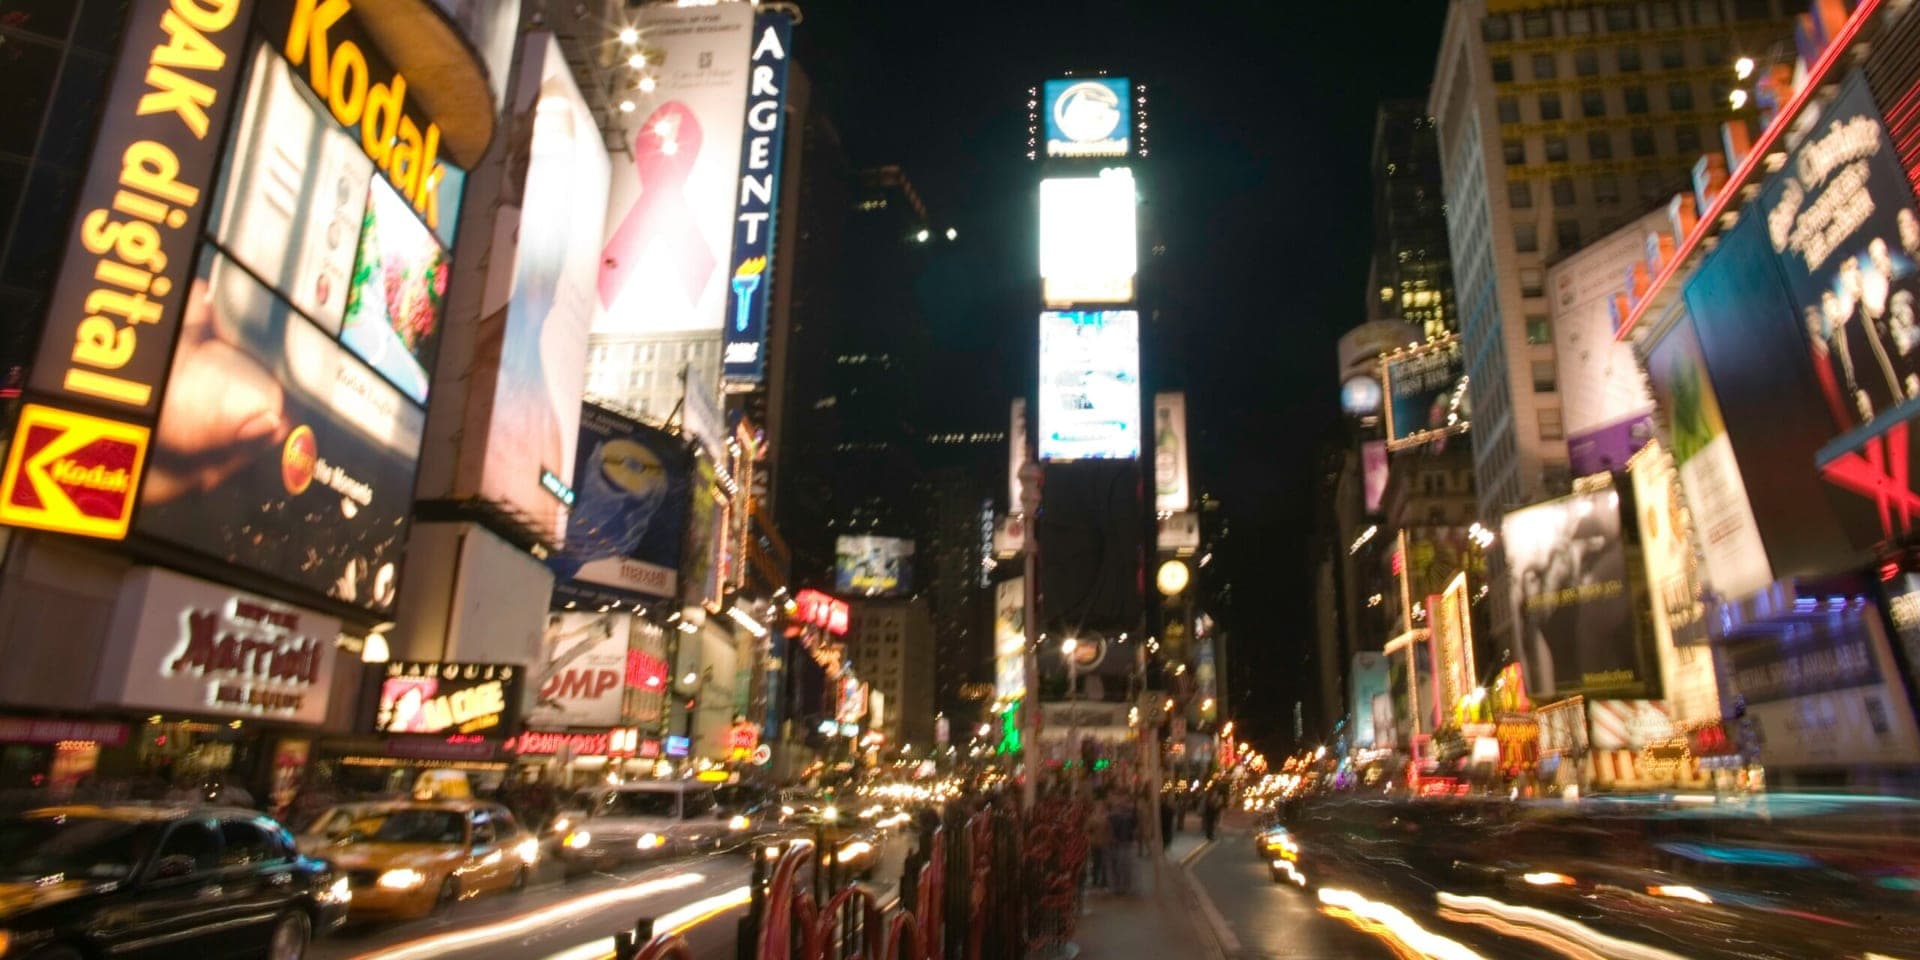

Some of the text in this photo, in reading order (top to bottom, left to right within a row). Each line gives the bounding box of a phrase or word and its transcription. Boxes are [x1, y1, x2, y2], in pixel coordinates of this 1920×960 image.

[286, 0, 446, 230] Kodak
[739, 26, 785, 244] ARGENT
[64, 141, 199, 406] digital
[52, 458, 130, 492] Kodak
[981, 509, 994, 588] NOVOL
